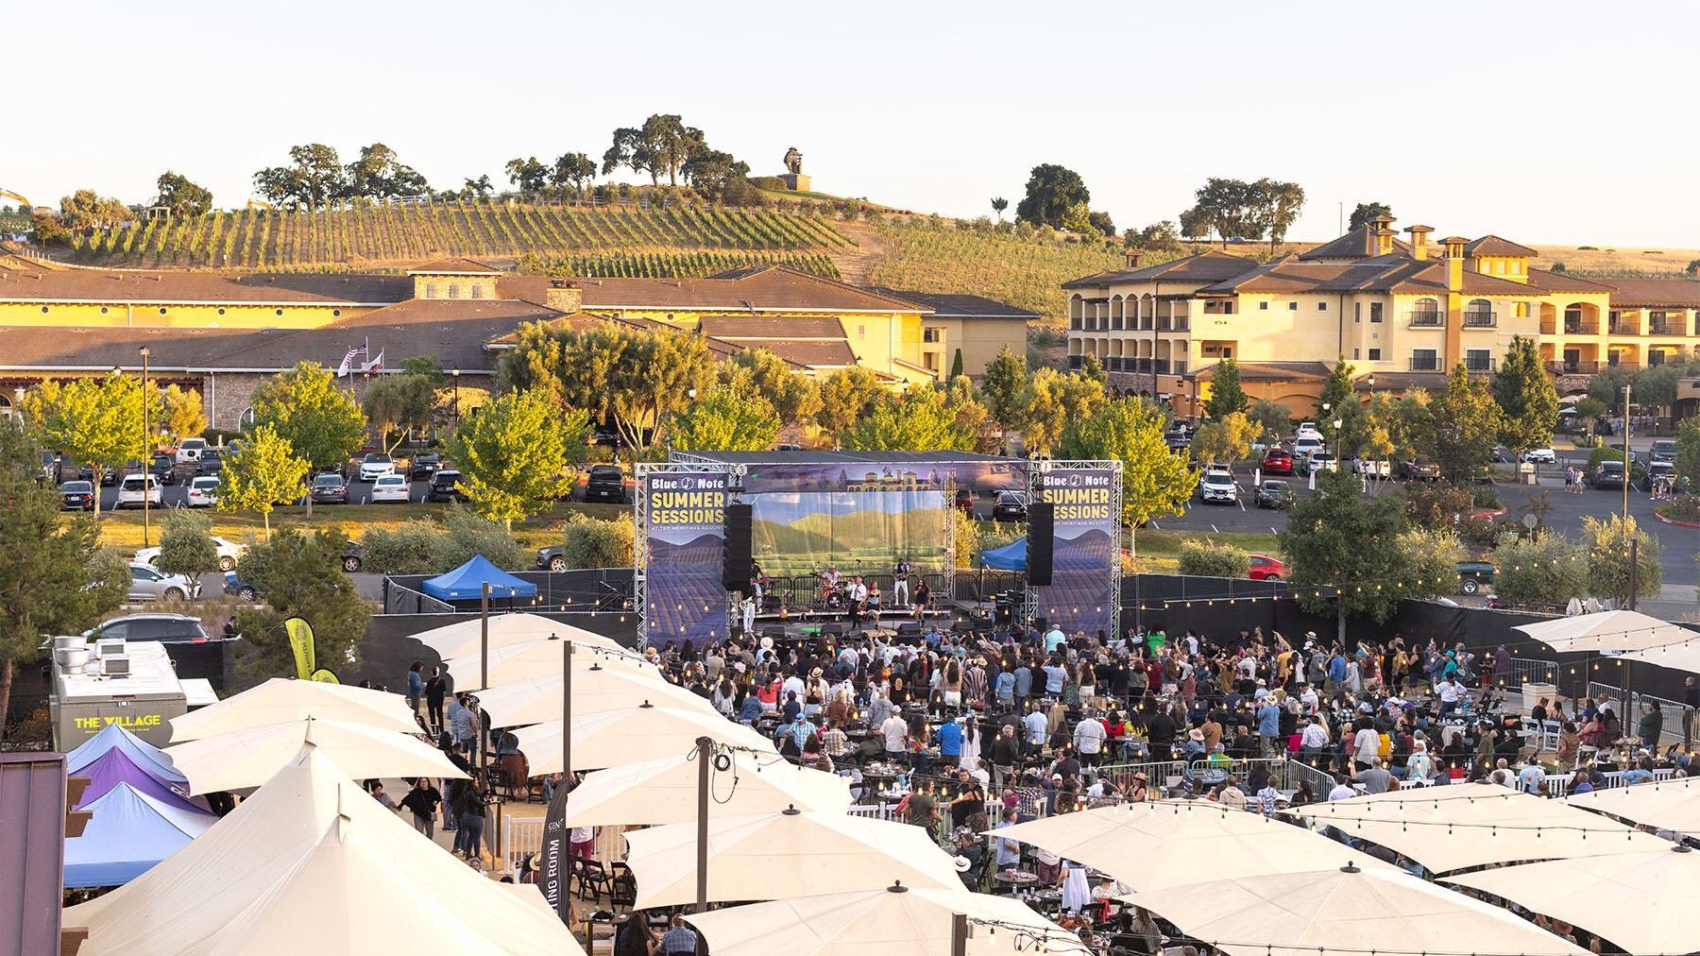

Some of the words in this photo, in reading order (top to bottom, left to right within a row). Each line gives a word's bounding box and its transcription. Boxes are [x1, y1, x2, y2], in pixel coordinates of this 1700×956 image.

[651, 478, 678, 489] Blue
[697, 478, 724, 489] Note
[1043, 476, 1067, 486] Blue
[1085, 475, 1109, 486] Note
[651, 492, 724, 508] SUMMER
[1043, 488, 1109, 504] SUMMER
[651, 509, 724, 524] SESSIONS
[1053, 505, 1109, 519] ESSIONS
[74, 717, 100, 728] THE
[104, 714, 161, 726] VILLAGE
[548, 839, 560, 877] ROOM
